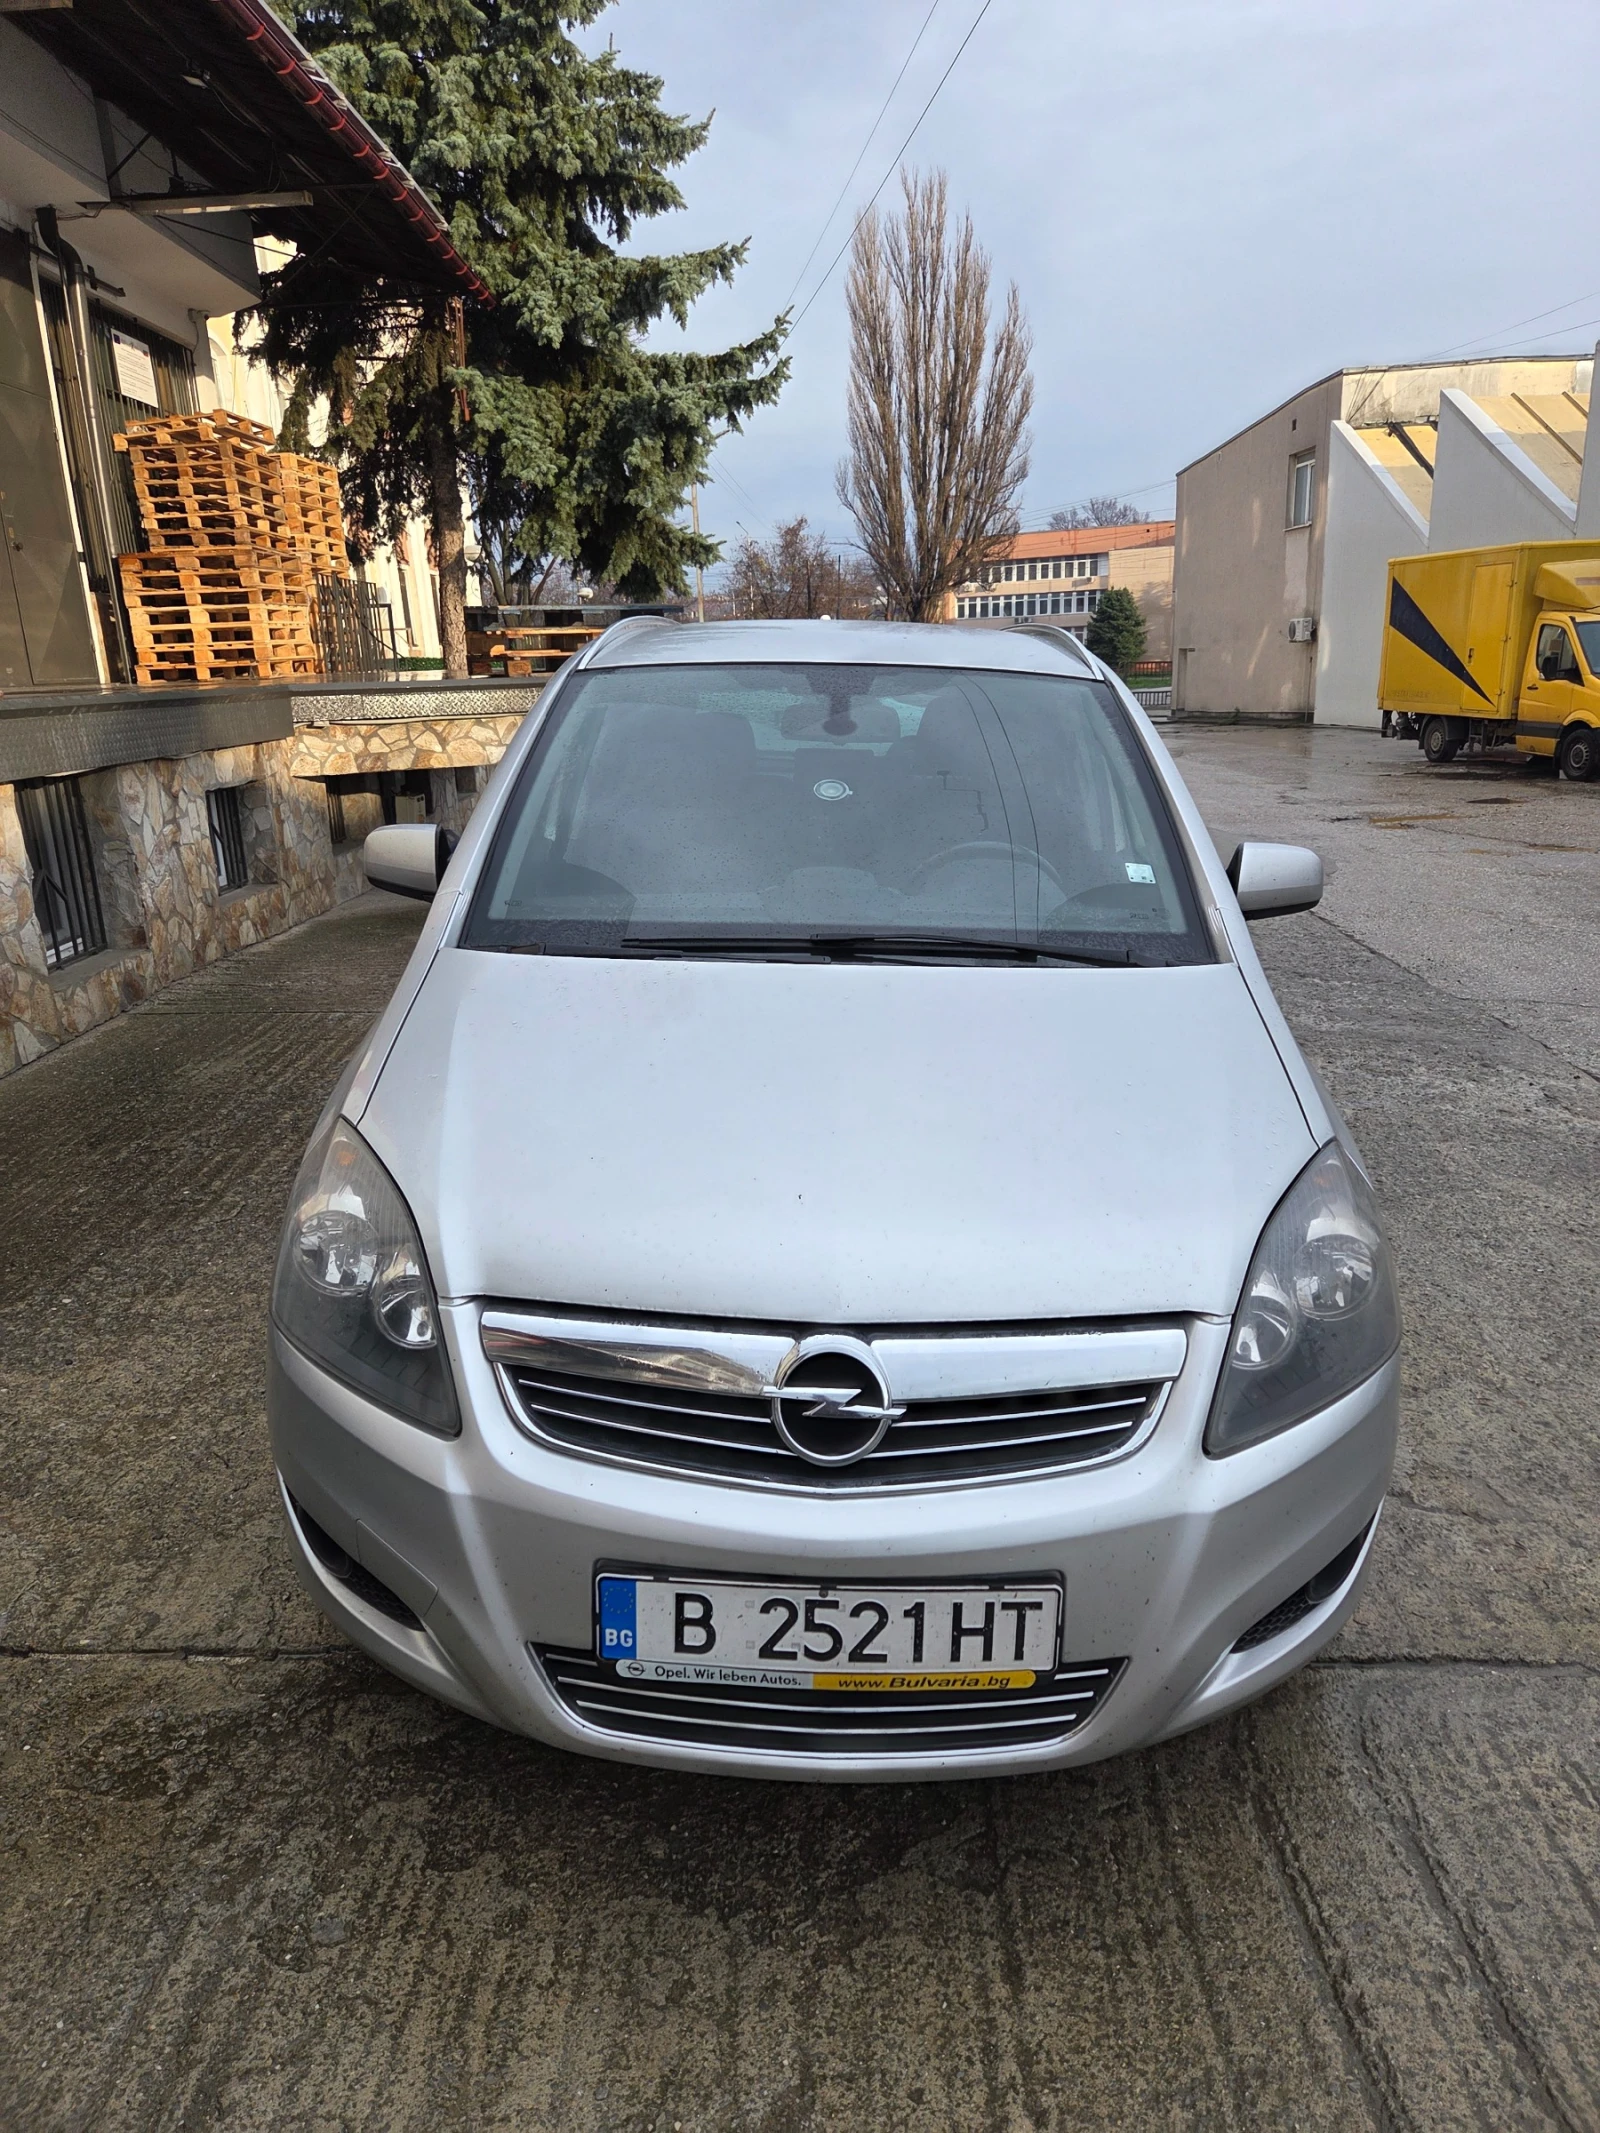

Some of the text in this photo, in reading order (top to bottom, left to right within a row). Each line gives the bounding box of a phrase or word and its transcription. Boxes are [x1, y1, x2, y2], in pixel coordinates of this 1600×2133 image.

[605, 1628, 633, 1647] BG
[674, 1592, 1043, 1662] B 2521 HT
[654, 1665, 801, 1686] Opel. Wir leben Autos.
